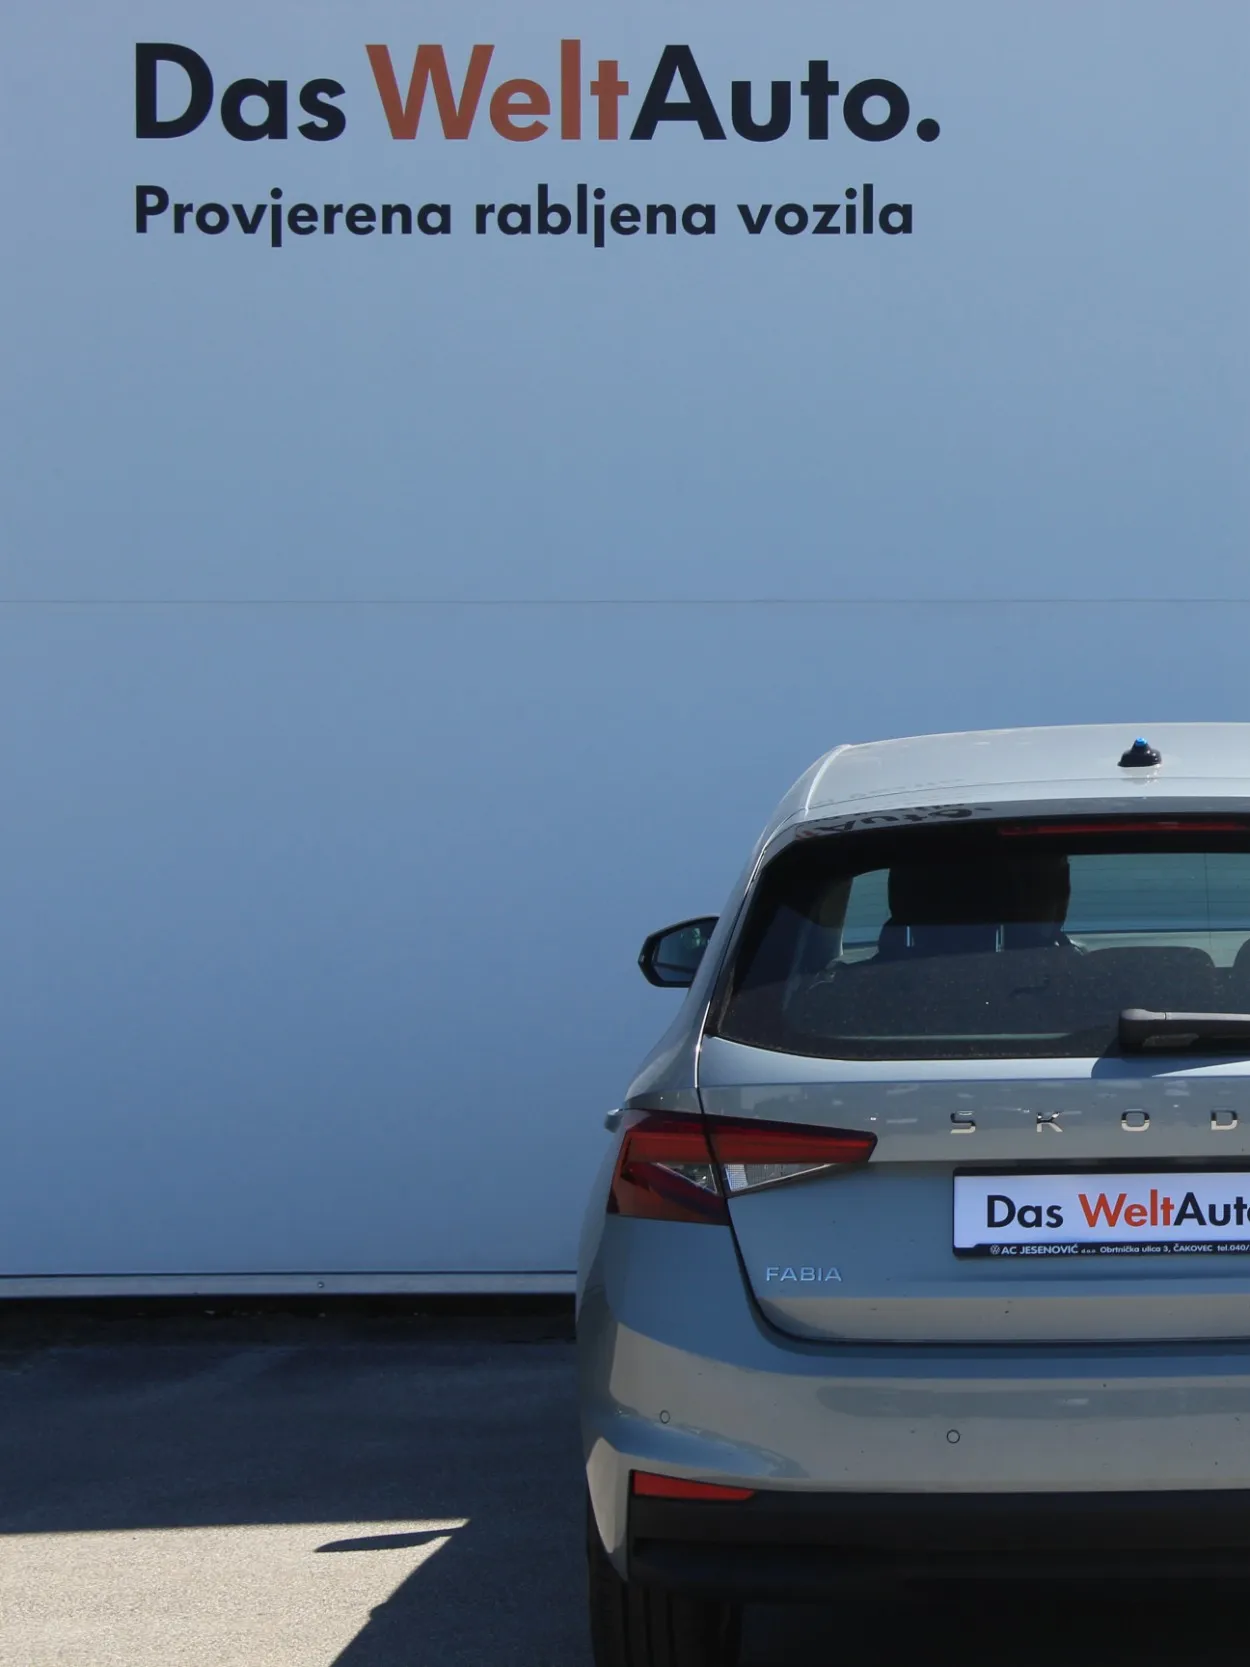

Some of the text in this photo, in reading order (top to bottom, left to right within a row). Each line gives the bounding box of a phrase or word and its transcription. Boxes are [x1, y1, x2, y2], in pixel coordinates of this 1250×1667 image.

[135, 39, 941, 143] Das WeltAuto.
[135, 183, 913, 248] Provjerena rabljena vozila
[986, 1194, 1064, 1228] Das
[1001, 1246, 1017, 1255] AC
[1020, 1243, 1079, 1254] JESENOVIĆ
[1100, 1244, 1140, 1254] Obrtnička
[1142, 1245, 1161, 1253] ulica
[1163, 1245, 1171, 1253] 3,
[1173, 1242, 1213, 1252] ČAKOVEC
[766, 1267, 841, 1281] FABIA
